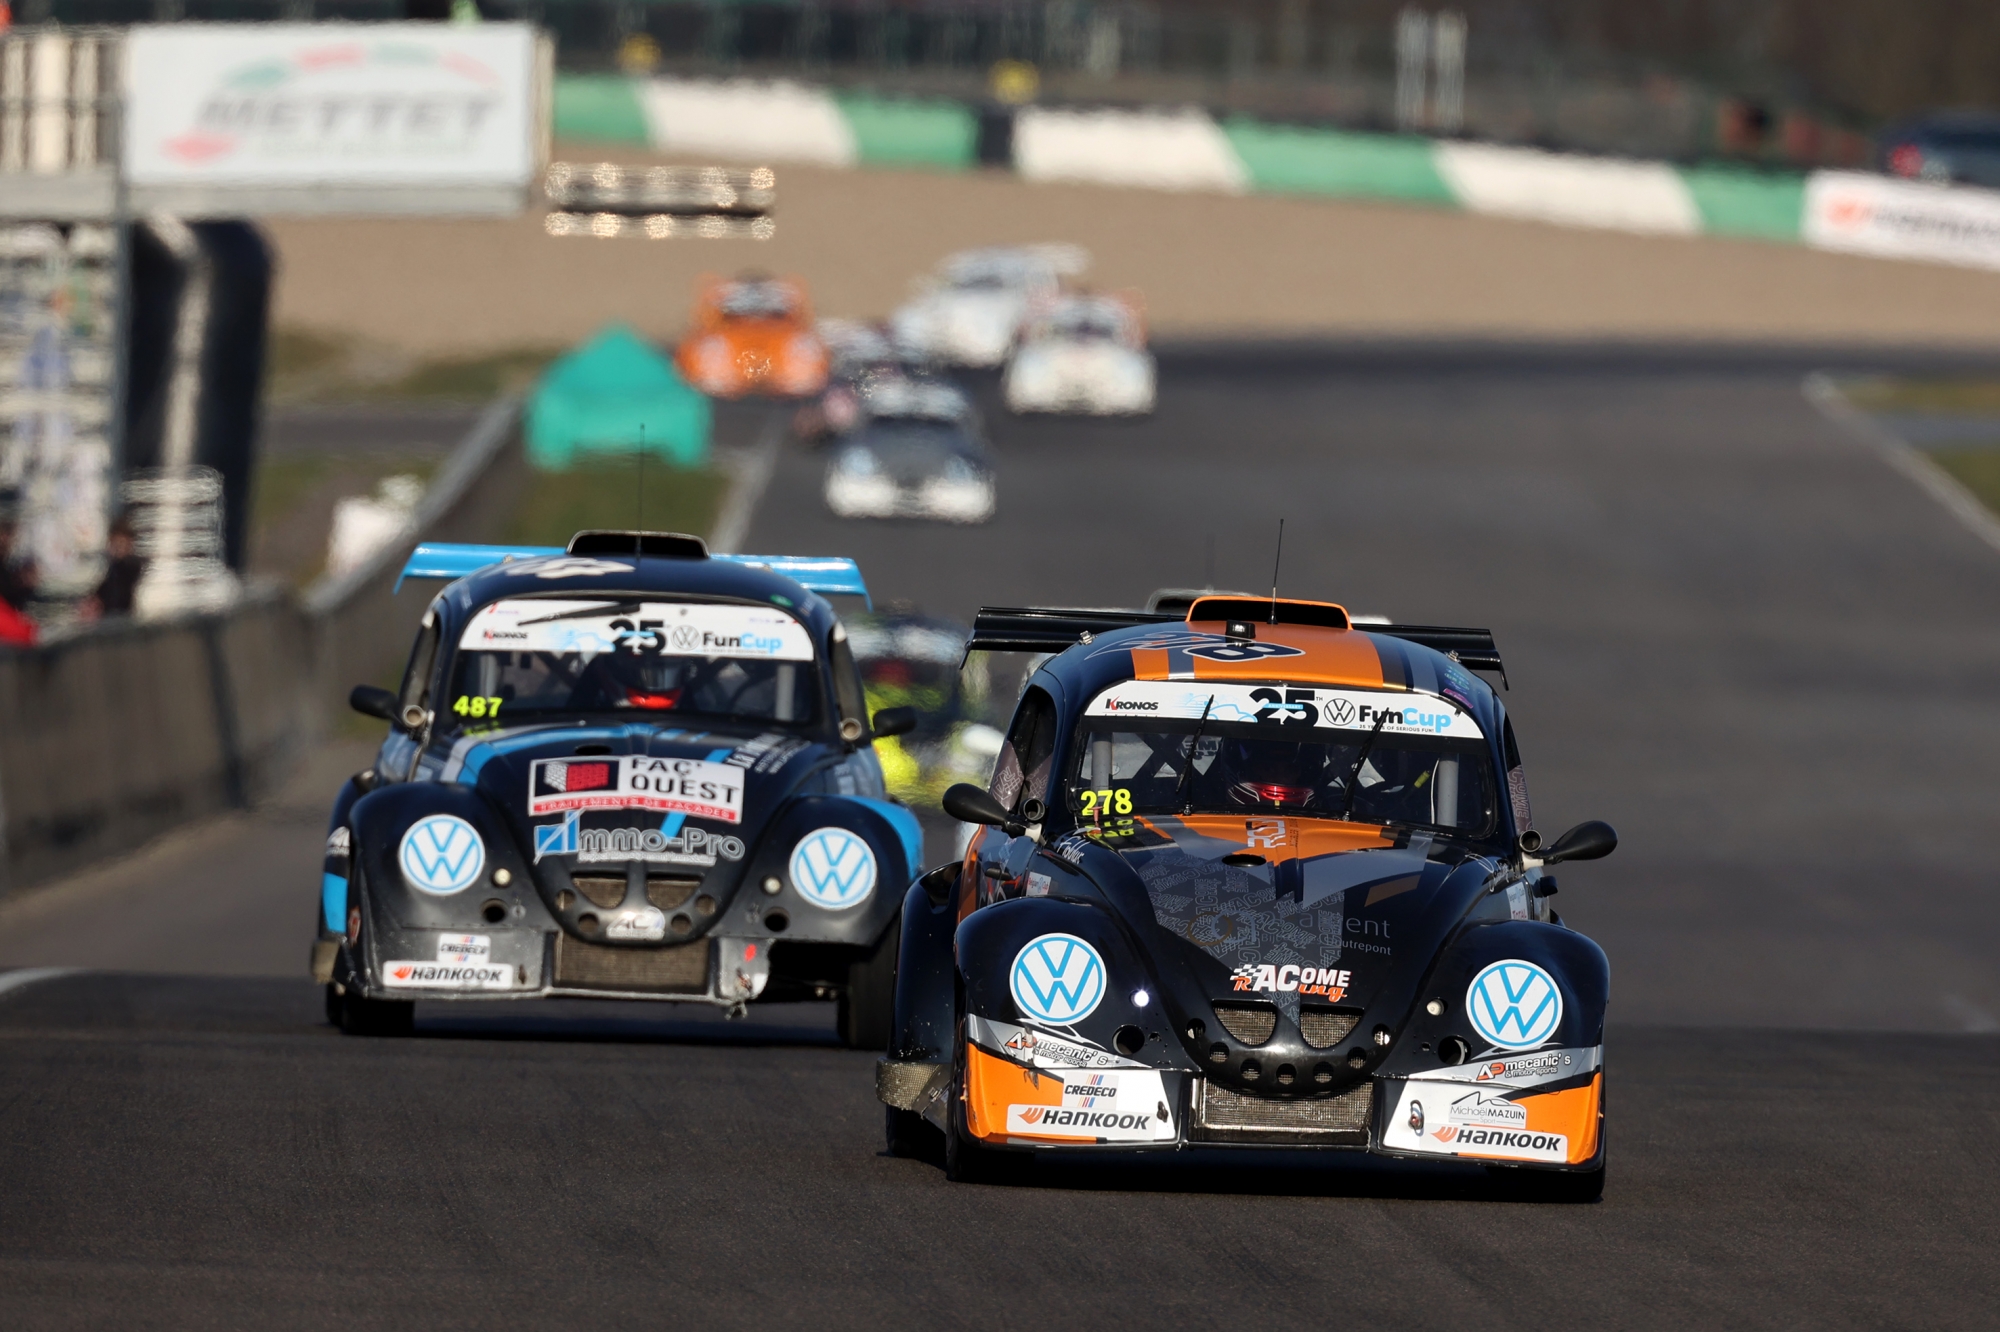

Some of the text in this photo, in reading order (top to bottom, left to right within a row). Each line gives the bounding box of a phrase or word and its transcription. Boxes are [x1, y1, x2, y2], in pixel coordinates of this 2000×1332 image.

[196, 92, 504, 136] METTET
[609, 617, 667, 655] 25
[702, 631, 783, 655] FunCup
[453, 695, 503, 718] 487
[1105, 696, 1159, 711] KRONOS
[1248, 687, 1319, 727] 25
[1359, 705, 1452, 733] FunCup
[540, 797, 730, 819] TRAITEMENTS DE FAÇADES
[1080, 788, 1133, 816] 278
[1476, 1062, 1505, 1081] AP
[1505, 1066, 1557, 1078] & motor sports
[1064, 1084, 1117, 1098] CREDECO
